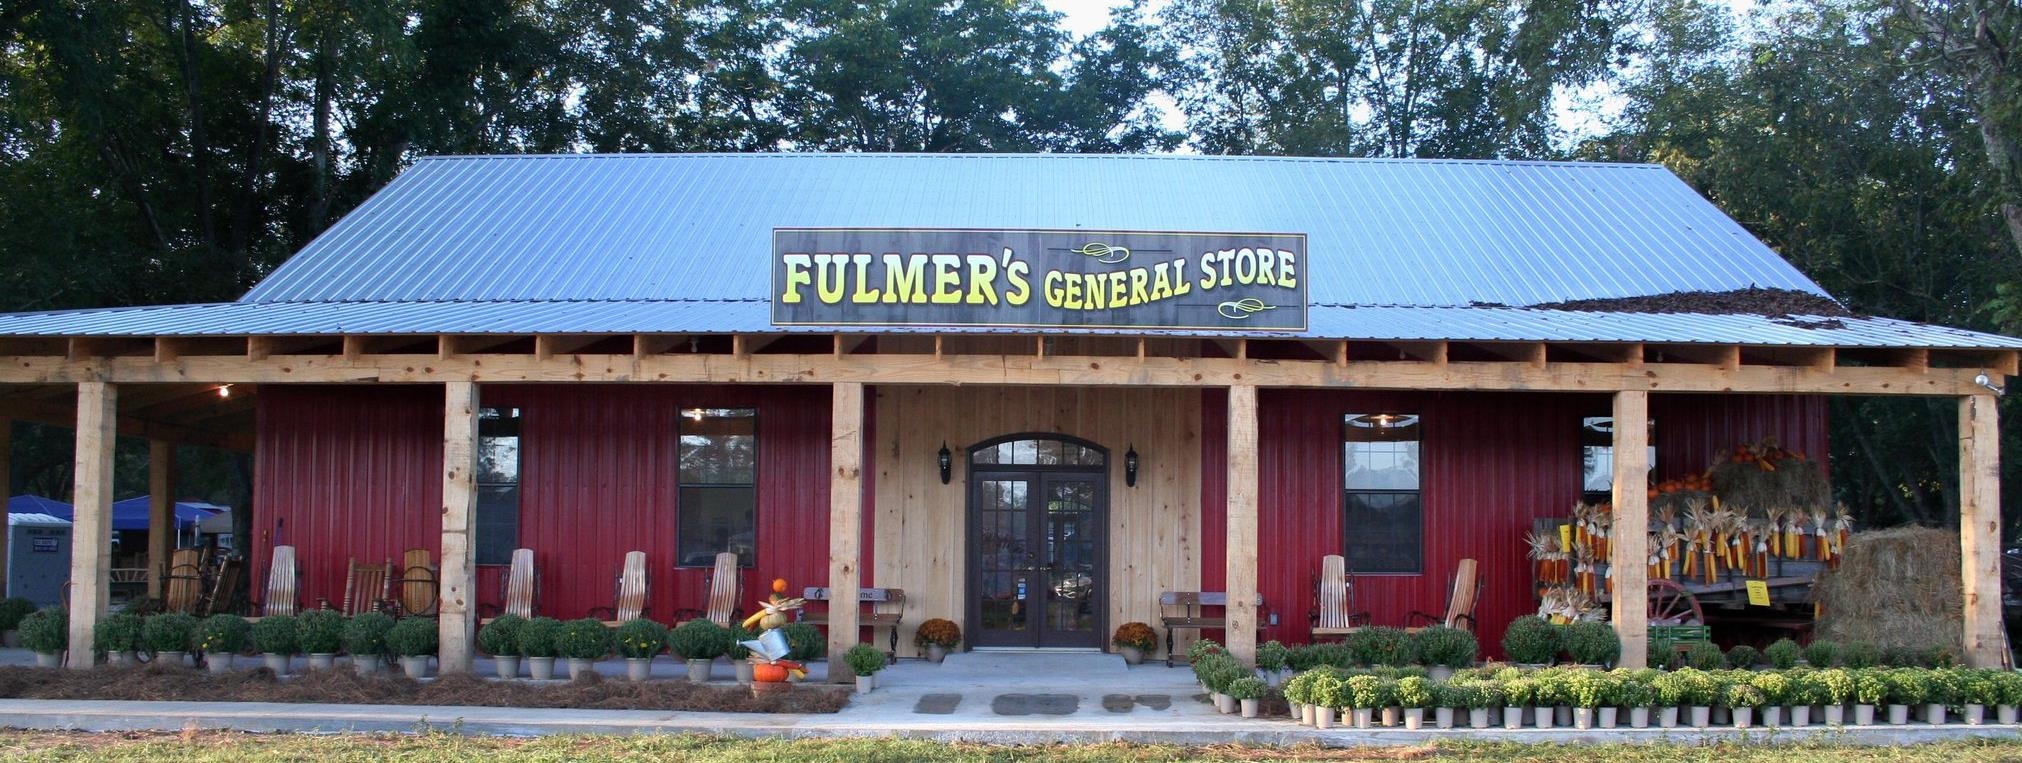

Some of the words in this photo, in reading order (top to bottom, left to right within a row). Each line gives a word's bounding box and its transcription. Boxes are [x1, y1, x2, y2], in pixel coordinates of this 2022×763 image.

[782, 247, 1031, 306] FULMER'S
[1044, 258, 1192, 310] GENERAL
[1200, 247, 1297, 290] STORE
